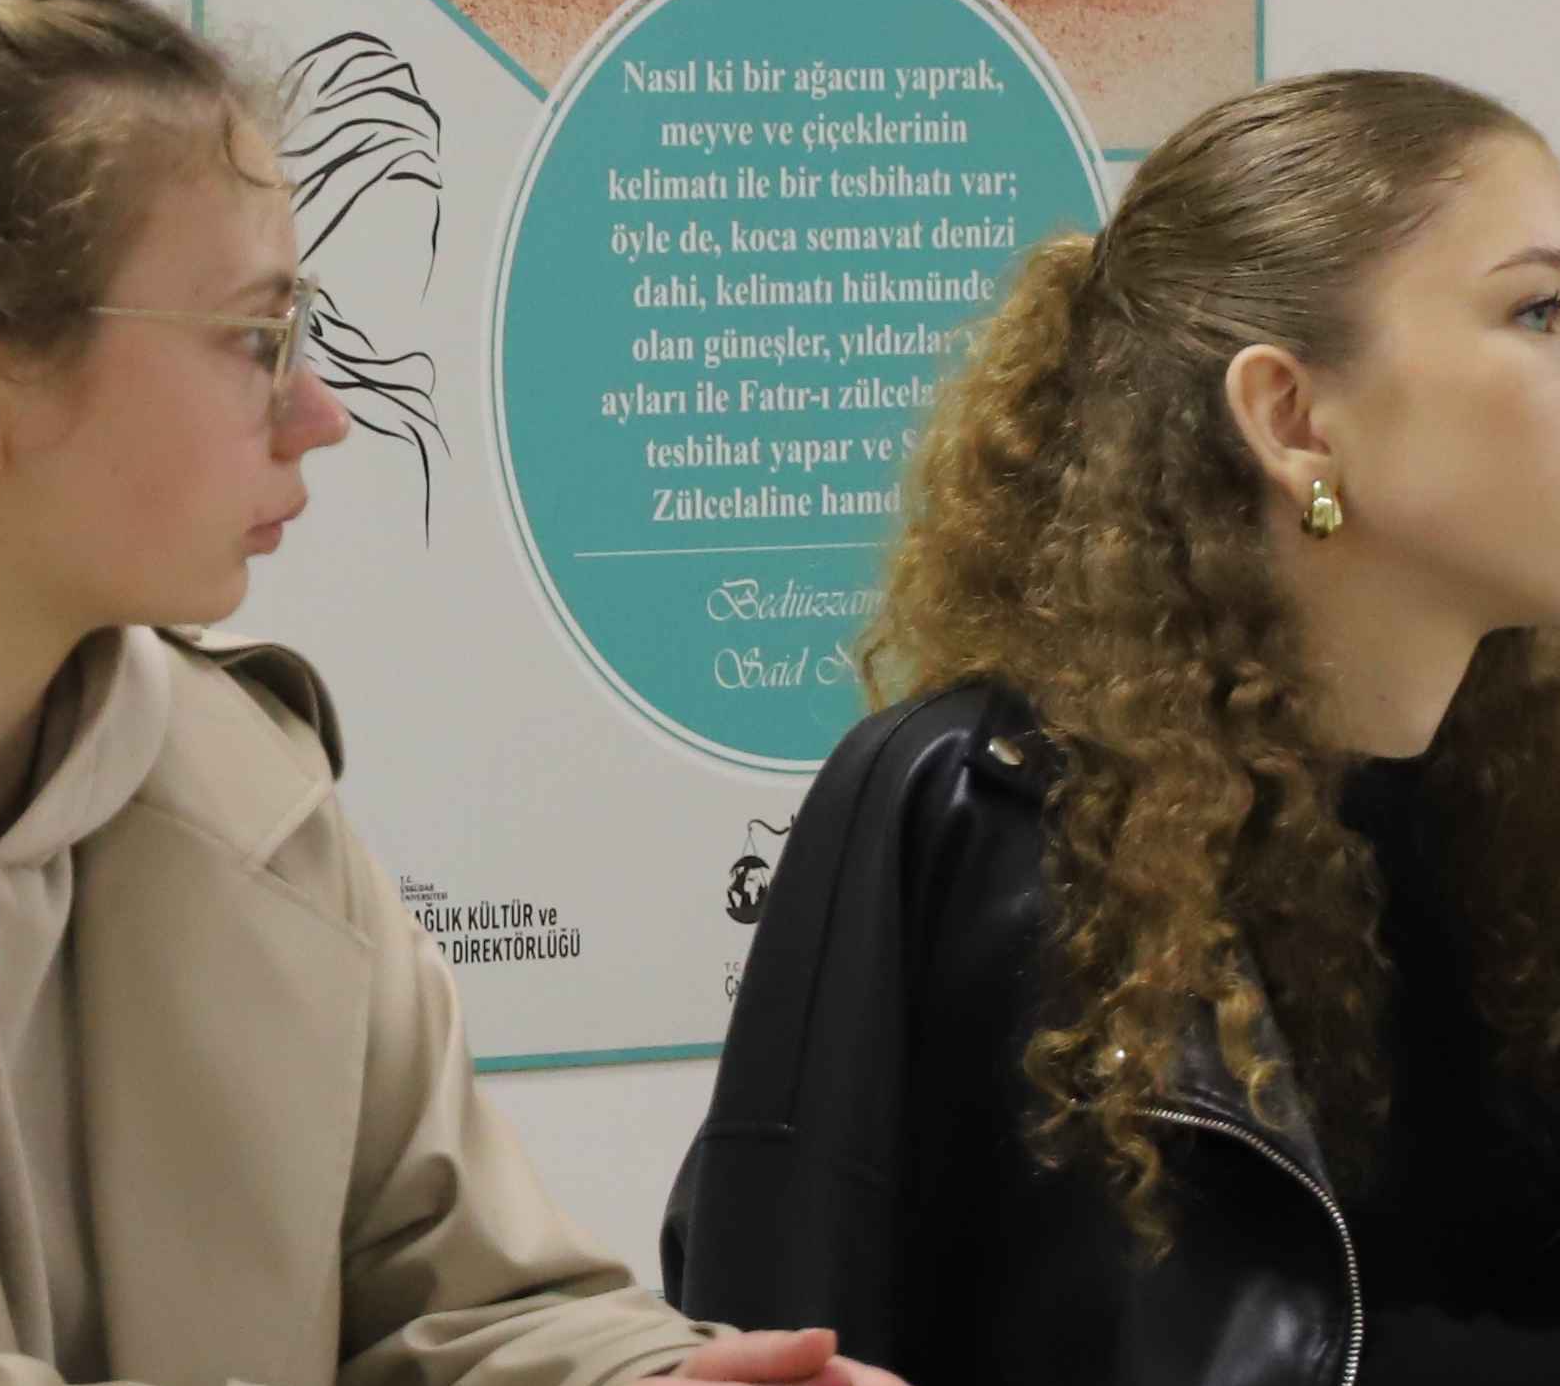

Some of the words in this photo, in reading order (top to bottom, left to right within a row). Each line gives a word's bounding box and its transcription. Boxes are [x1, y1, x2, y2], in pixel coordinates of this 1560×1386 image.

[622, 59, 698, 94] Nasıl
[705, 58, 736, 94] ki
[742, 58, 788, 94] bir
[793, 60, 886, 101] ağacın
[894, 58, 1005, 102] yaprak,
[660, 121, 754, 155] meyve
[762, 122, 794, 146] ve
[801, 110, 969, 153] çiçeklerinin
[607, 167, 729, 202] kelimatı
[736, 165, 771, 199] ile
[779, 165, 823, 199] bir
[829, 164, 952, 198] tesbihatı
[960, 171, 1019, 199] var;
[610, 220, 671, 264] öyle
[678, 220, 723, 258] de,
[730, 220, 798, 253] koca
[806, 220, 923, 252] semavat
[931, 215, 1015, 249] denizi
[632, 274, 707, 311] dahi,
[716, 272, 833, 307] kelimatı
[842, 269, 994, 304] hükmünde
[631, 327, 695, 362] olan
[703, 324, 832, 369] güneşler,
[600, 381, 688, 426] ayları
[695, 380, 731, 414] ile
[739, 379, 831, 413] Fatır-ı
[838, 377, 936, 410] zülcela
[644, 433, 761, 469] tesbihat
[768, 439, 853, 474] yapar
[862, 439, 892, 460] ve
[651, 484, 813, 523] Zülcelaline
[706, 578, 887, 621] Bediüzzam
[713, 646, 809, 690] Said
[415, 902, 462, 933] ĞLIK
[468, 899, 533, 931] KÜLTÜR
[538, 906, 558, 926] ve
[453, 928, 581, 964] DİREKTÖRLÜĞÜ
